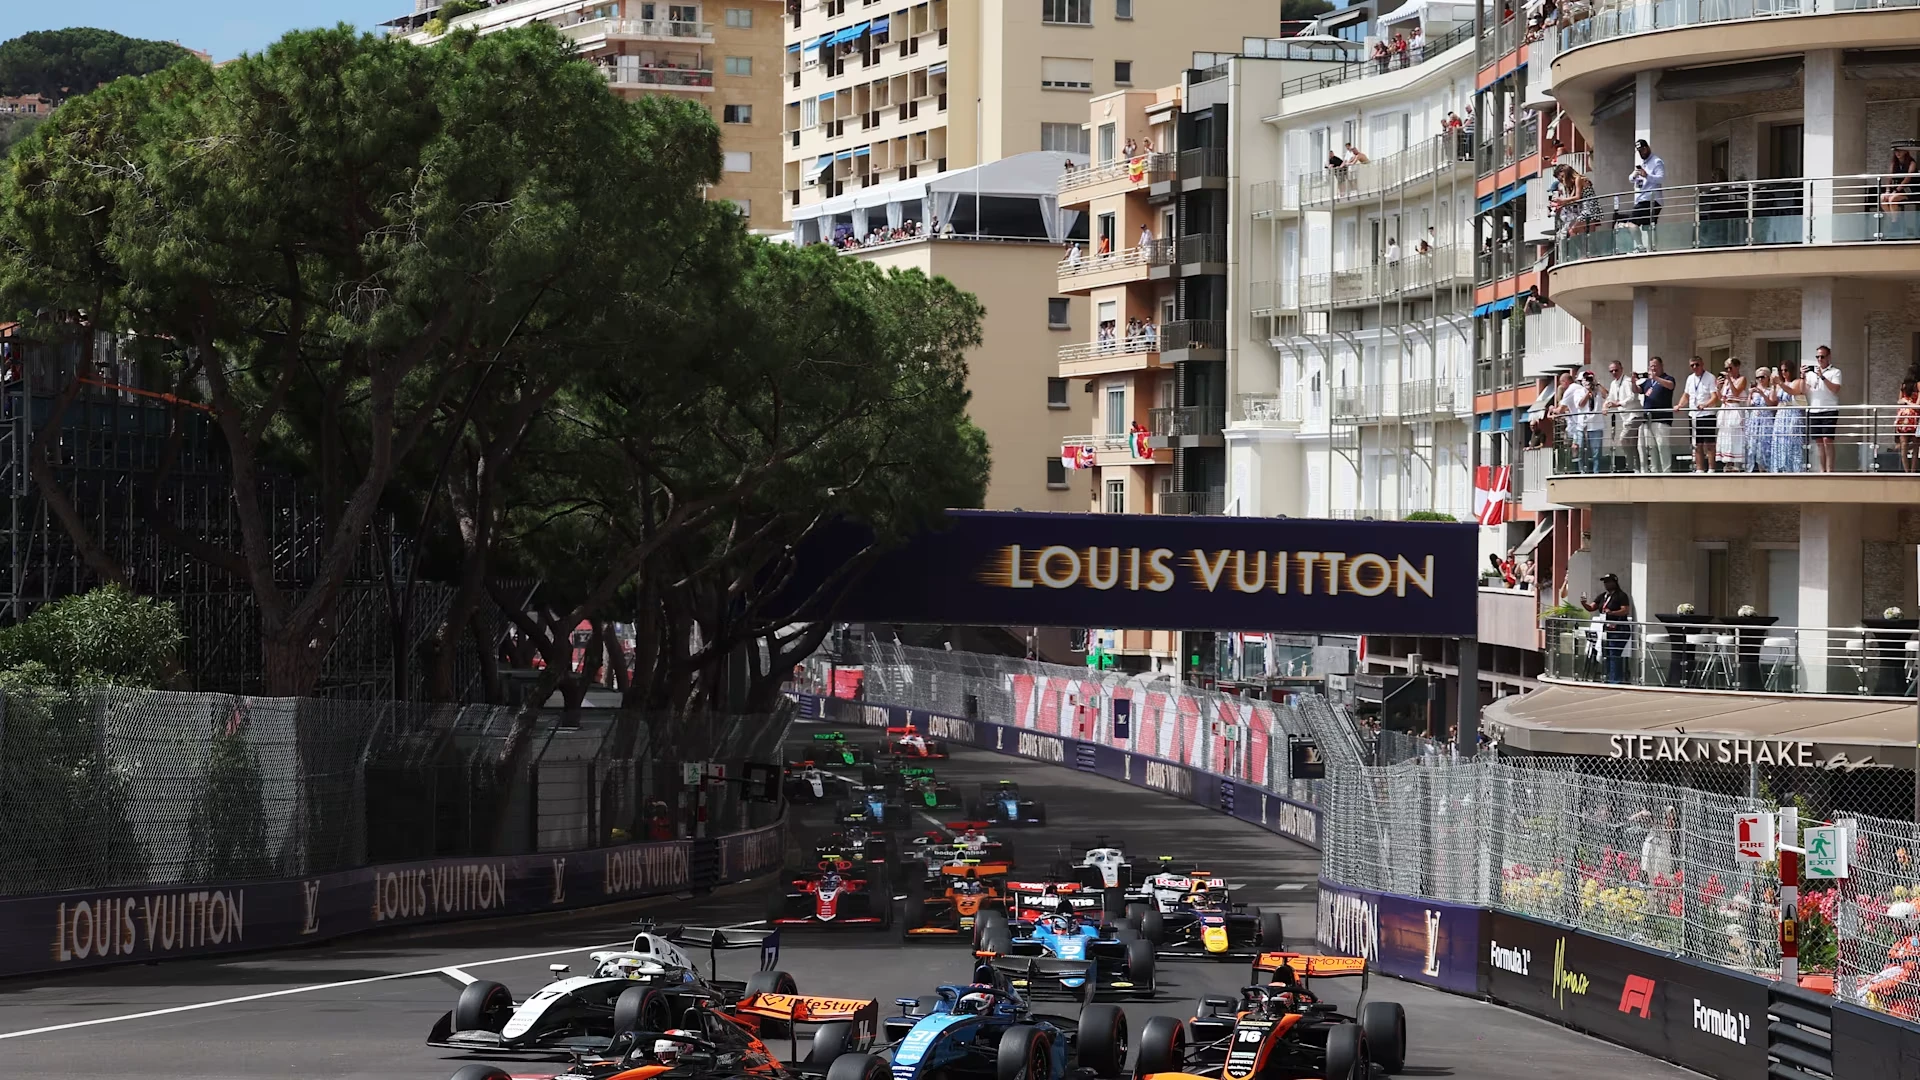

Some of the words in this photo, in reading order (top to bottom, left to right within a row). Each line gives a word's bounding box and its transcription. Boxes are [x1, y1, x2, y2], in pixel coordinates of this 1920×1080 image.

[1009, 543, 1174, 592] LOUIS
[1194, 547, 1435, 598] VUITTON
[929, 714, 948, 738] LOUIS
[948, 717, 975, 742] VUITTON
[1019, 731, 1037, 757] LOUIS
[1037, 735, 1064, 762] VUITTON
[1609, 733, 1692, 763] STEAK
[1696, 743, 1710, 760] N
[1717, 738, 1814, 767] SHAKE
[1146, 760, 1165, 788] LOUIS
[1165, 763, 1192, 796] VUITTON
[606, 850, 643, 894] LOUIS
[645, 845, 690, 886] VUITTON
[1155, 877, 1190, 887] Red
[375, 868, 426, 921] LOUIS
[431, 863, 506, 914] VUITTON
[58, 896, 137, 962] LOUIS
[144, 888, 244, 952] VUITTON
[1333, 893, 1379, 963] VUITTON
[1060, 945, 1081, 955] 9
[1490, 940, 1522, 975] Formula
[1552, 936, 1590, 1010] Monaco
[530, 990, 564, 1001] 17
[858, 1020, 871, 1051] 14
[906, 1030, 939, 1043] 31
[1238, 1030, 1262, 1043] 16
[1693, 998, 1740, 1043] Formula
